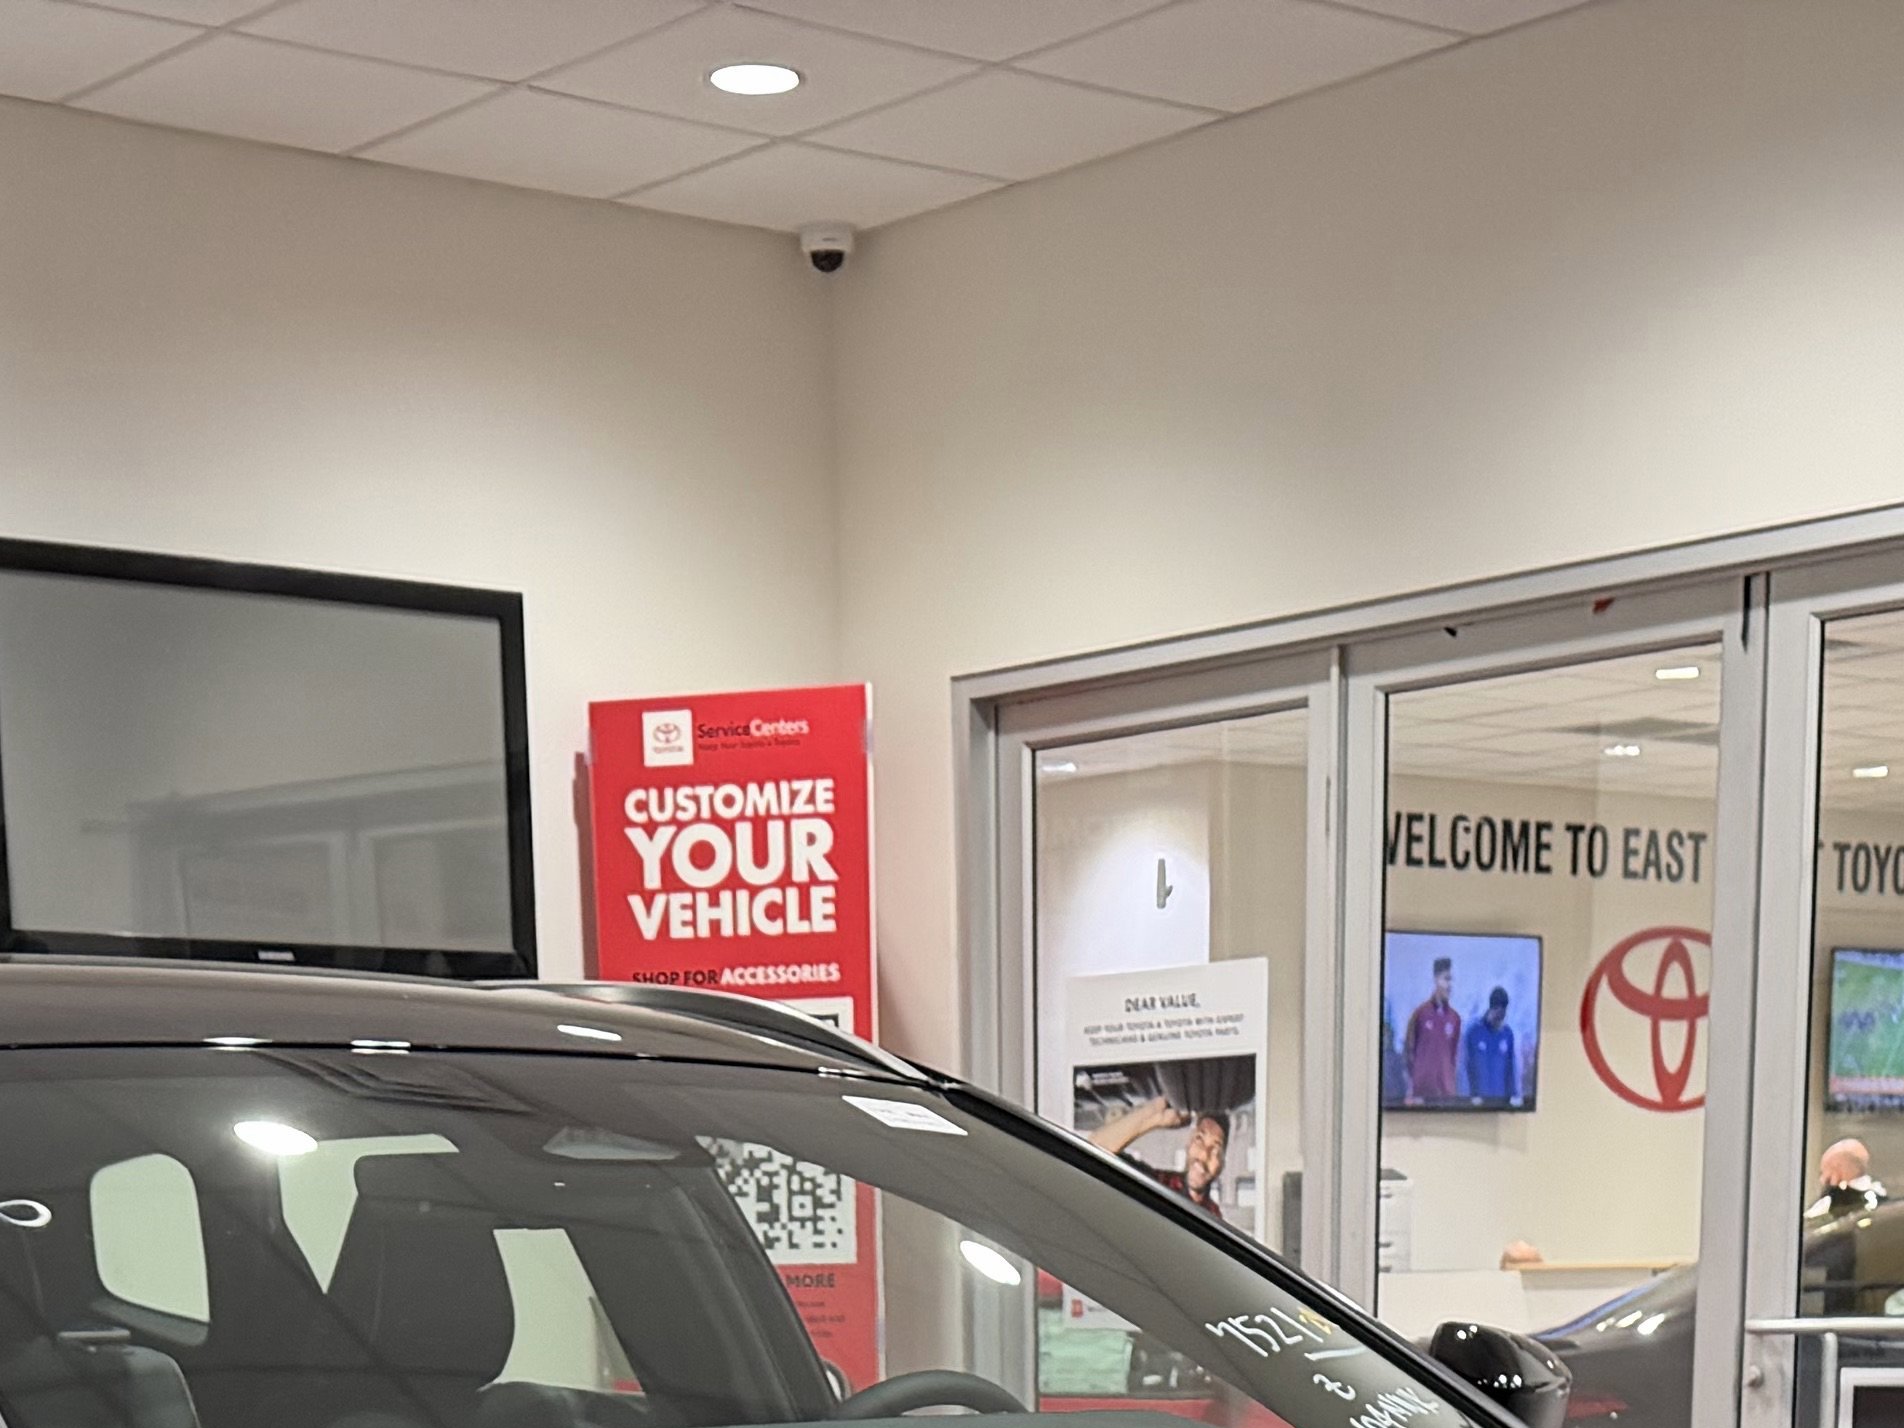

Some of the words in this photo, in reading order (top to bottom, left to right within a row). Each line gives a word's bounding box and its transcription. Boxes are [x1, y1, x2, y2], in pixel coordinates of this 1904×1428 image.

[624, 778, 836, 823] CUSTOMIZE
[624, 818, 839, 890] YOUR
[1565, 823, 1608, 879] TO
[1622, 827, 1707, 884] EAST
[627, 885, 837, 941] VEHICLE
[632, 970, 679, 986] SHOP
[683, 969, 718, 986] FOR
[721, 962, 840, 986] ACCESSORIES
[785, 1273, 835, 1288] MORE
